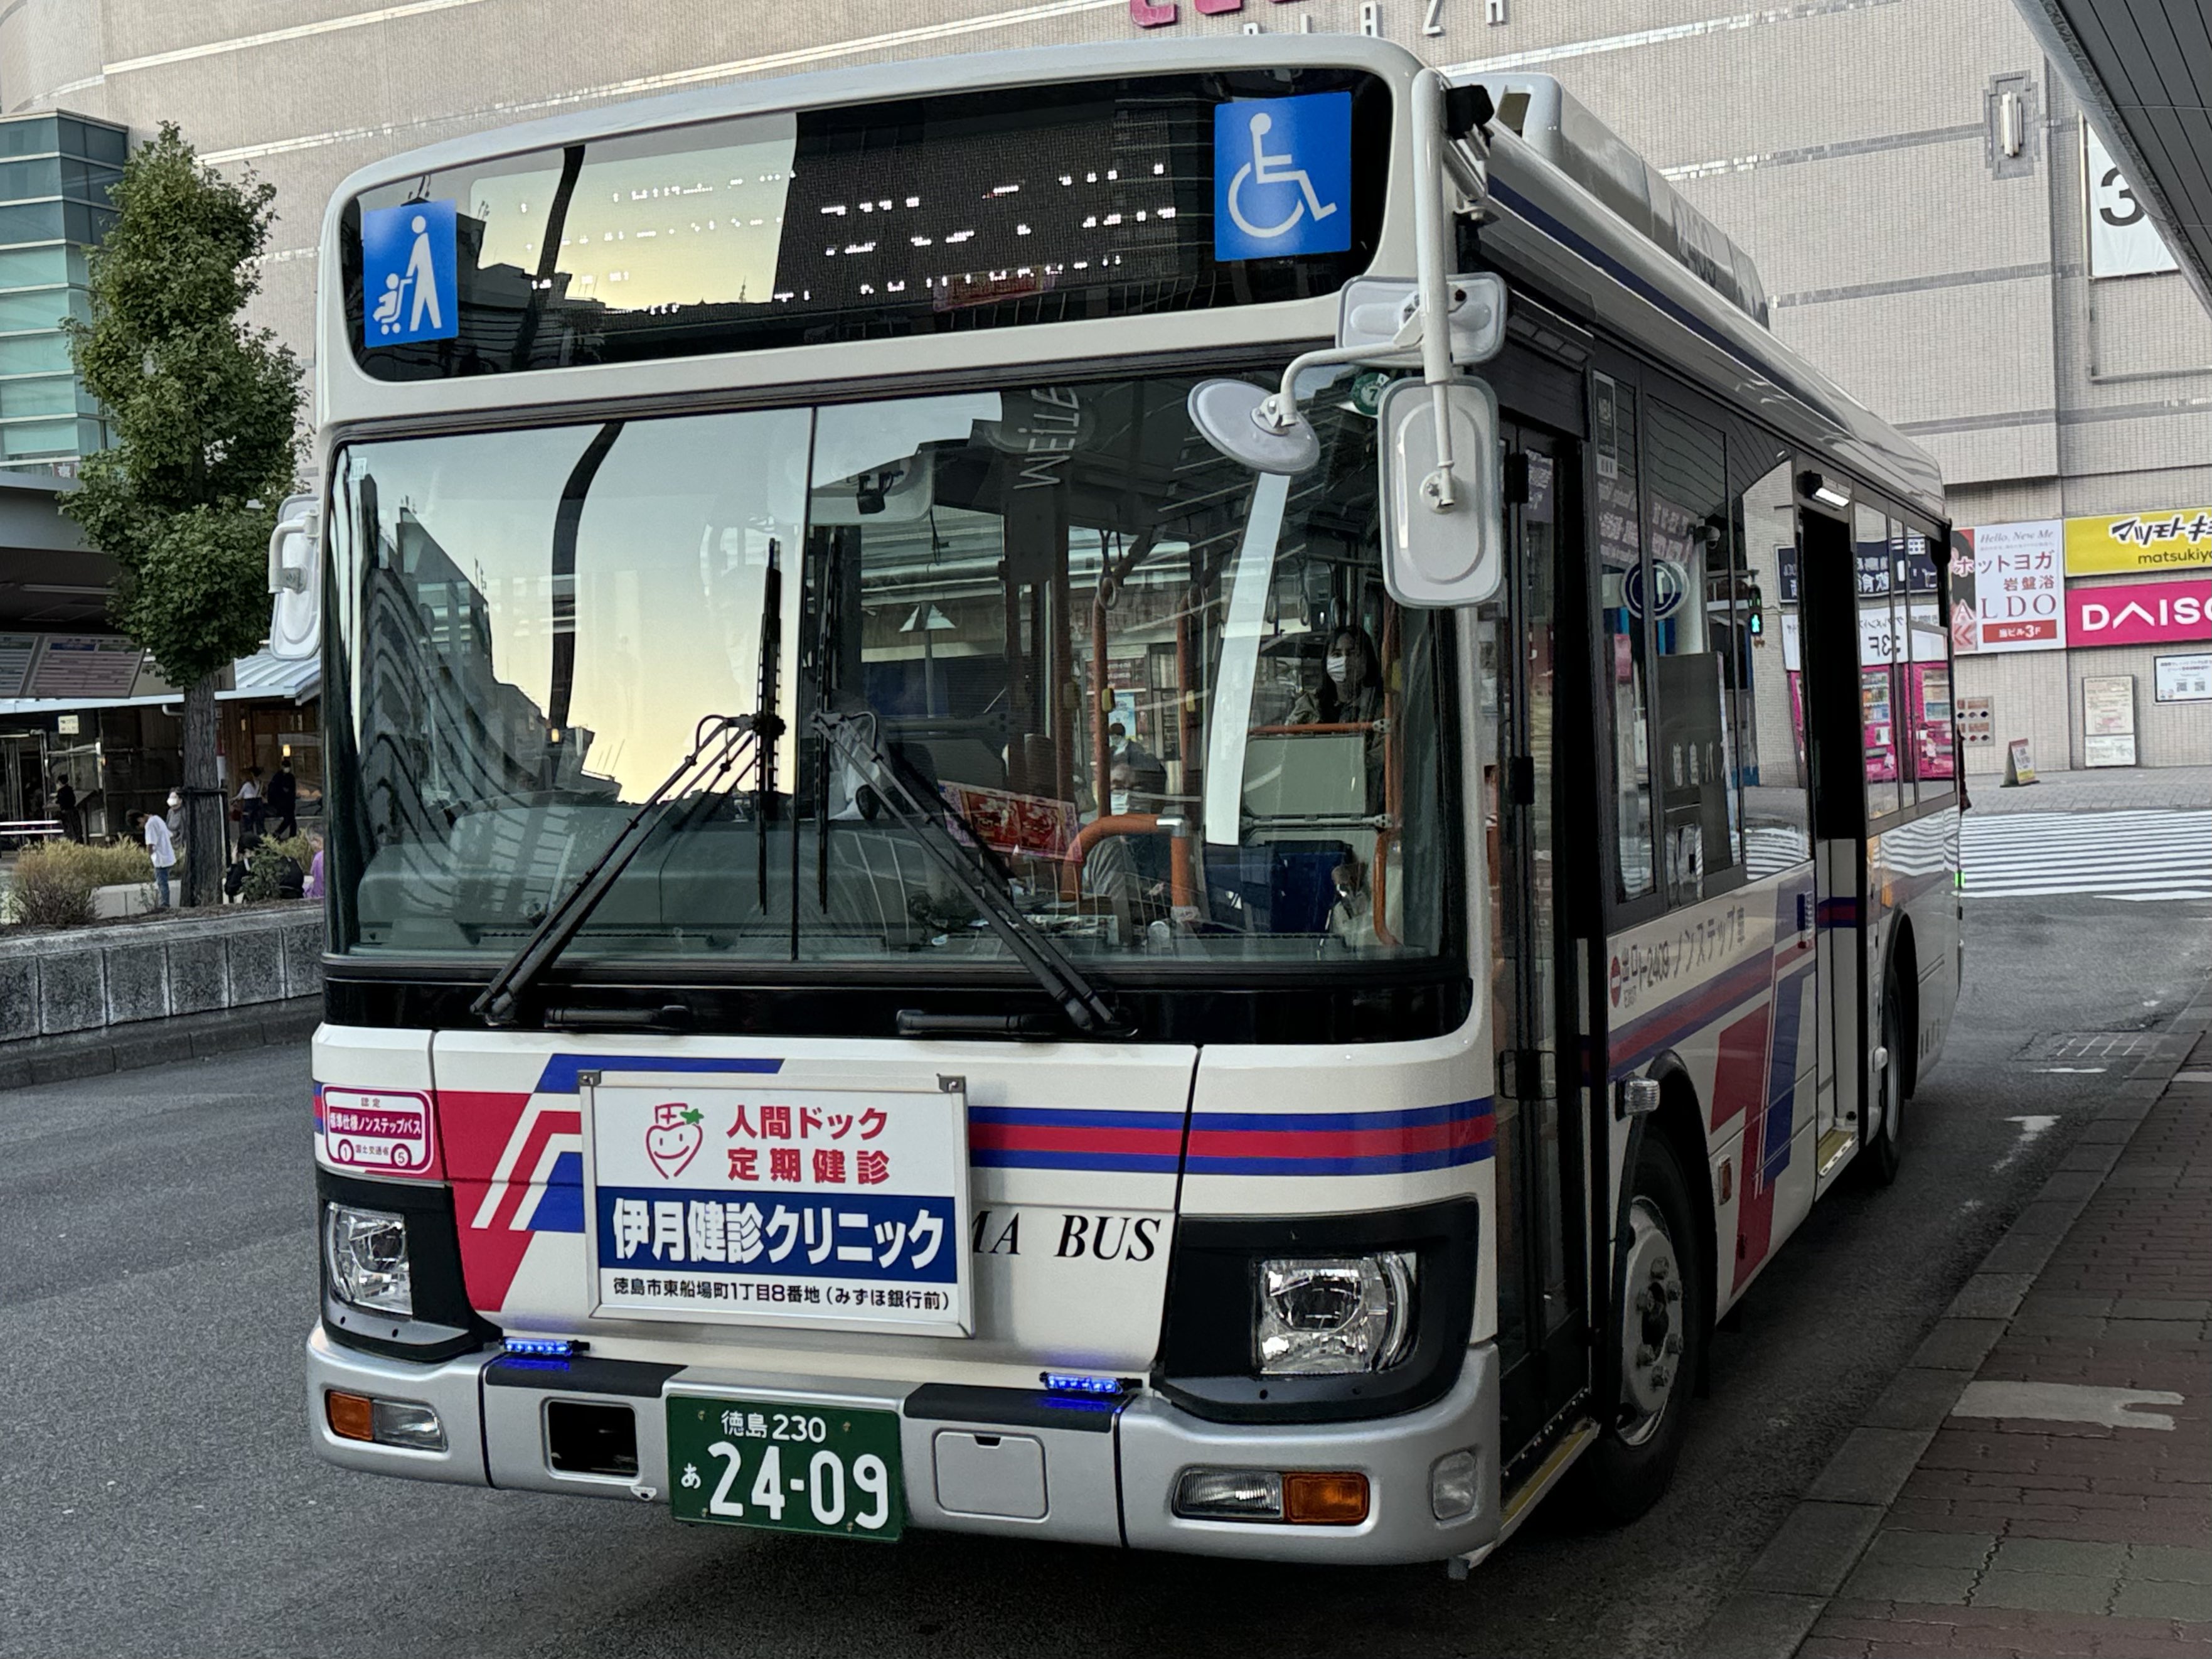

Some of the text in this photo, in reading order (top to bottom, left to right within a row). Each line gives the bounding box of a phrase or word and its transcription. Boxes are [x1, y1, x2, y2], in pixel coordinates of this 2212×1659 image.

[1369, 389, 1378, 401] 7
[2013, 532, 2035, 540] New
[2038, 529, 2054, 539] Me
[2112, 515, 2212, 545] マツモトキ
[1956, 549, 2055, 575] ホットヨガ
[2004, 576, 2054, 591] 岩盤浴
[361, 1097, 381, 1109] 認定
[329, 1112, 422, 1135] 標準仕様ノンステップバス
[726, 1104, 889, 1141] 人間ドック
[355, 1144, 389, 1156] 国土交通省
[397, 1151, 405, 1164] 5
[727, 1147, 890, 1186] 定期健診
[612, 1196, 944, 1270] 伊月健診クリニック
[1054, 1214, 1162, 1262] BUS
[680, 1441, 889, 1530] あ 24-09
